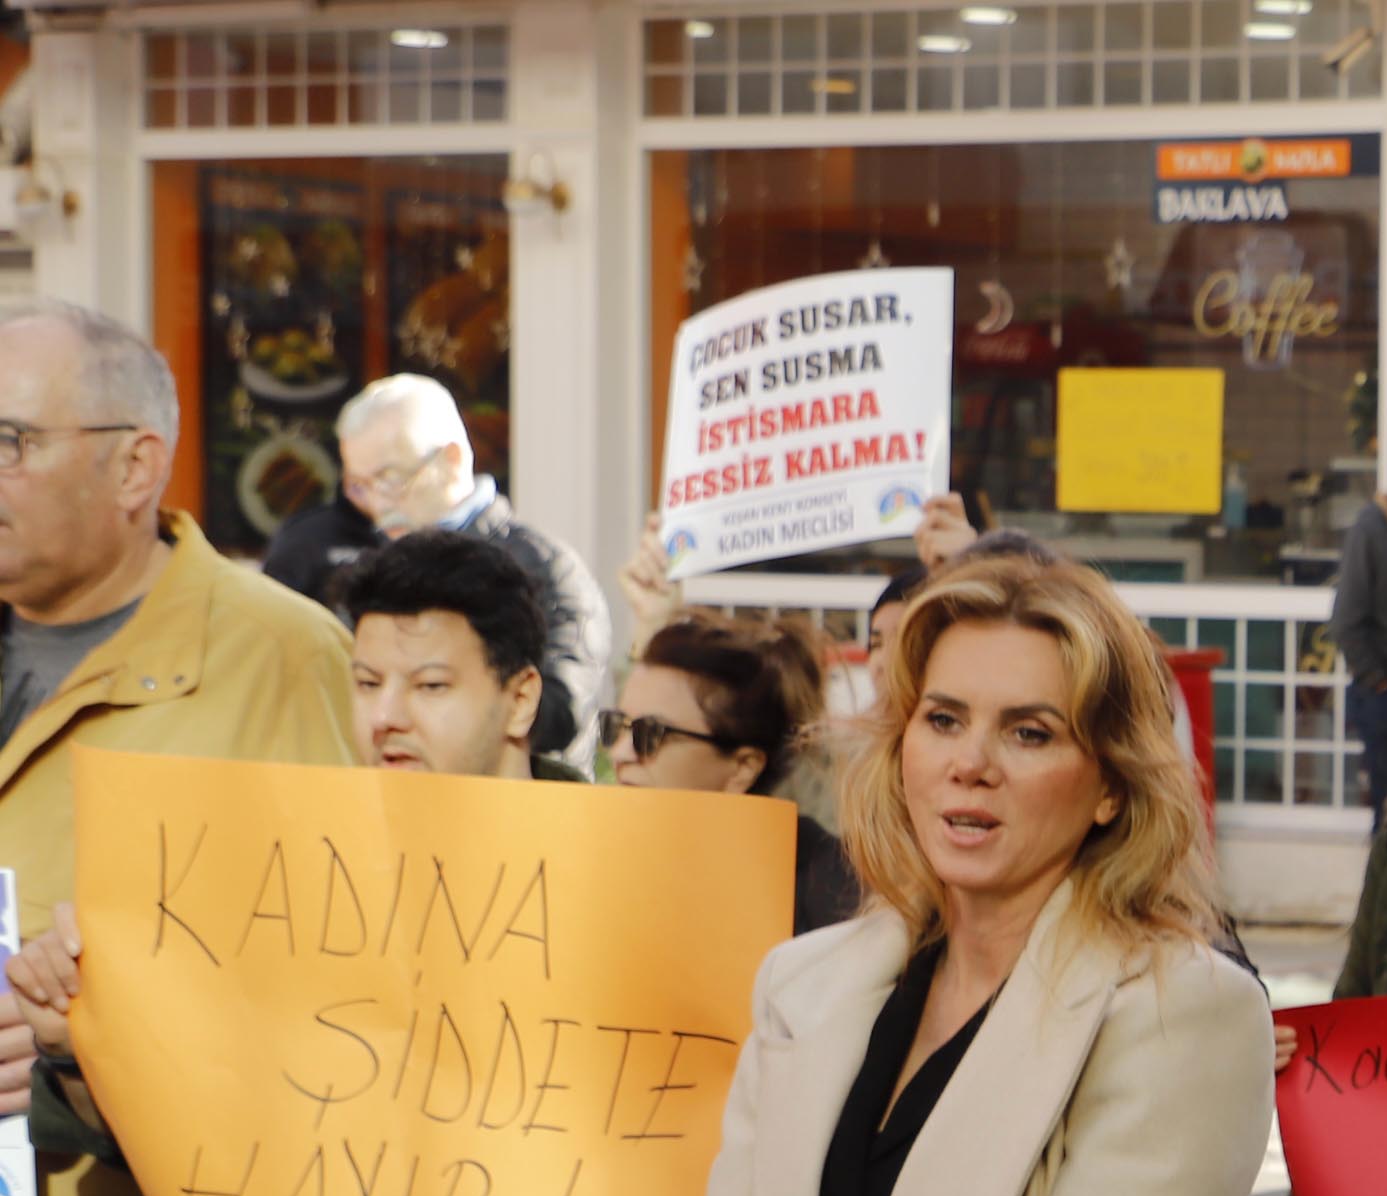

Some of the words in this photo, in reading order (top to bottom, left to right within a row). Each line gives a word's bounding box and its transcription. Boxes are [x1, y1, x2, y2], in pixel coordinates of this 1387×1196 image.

[1158, 187, 1288, 222] BAKLAVA
[778, 293, 913, 341] SUSAR,
[1193, 269, 1338, 359] Coffee
[699, 367, 750, 410] SEN
[761, 341, 883, 392] SUSMA
[697, 389, 880, 456] İSTİSMARA
[667, 453, 773, 508] SESSİZ
[785, 431, 926, 481] KALMA!
[718, 526, 775, 555] KADIN
[781, 504, 855, 541] MECLİSİ
[152, 820, 552, 981] KADINA
